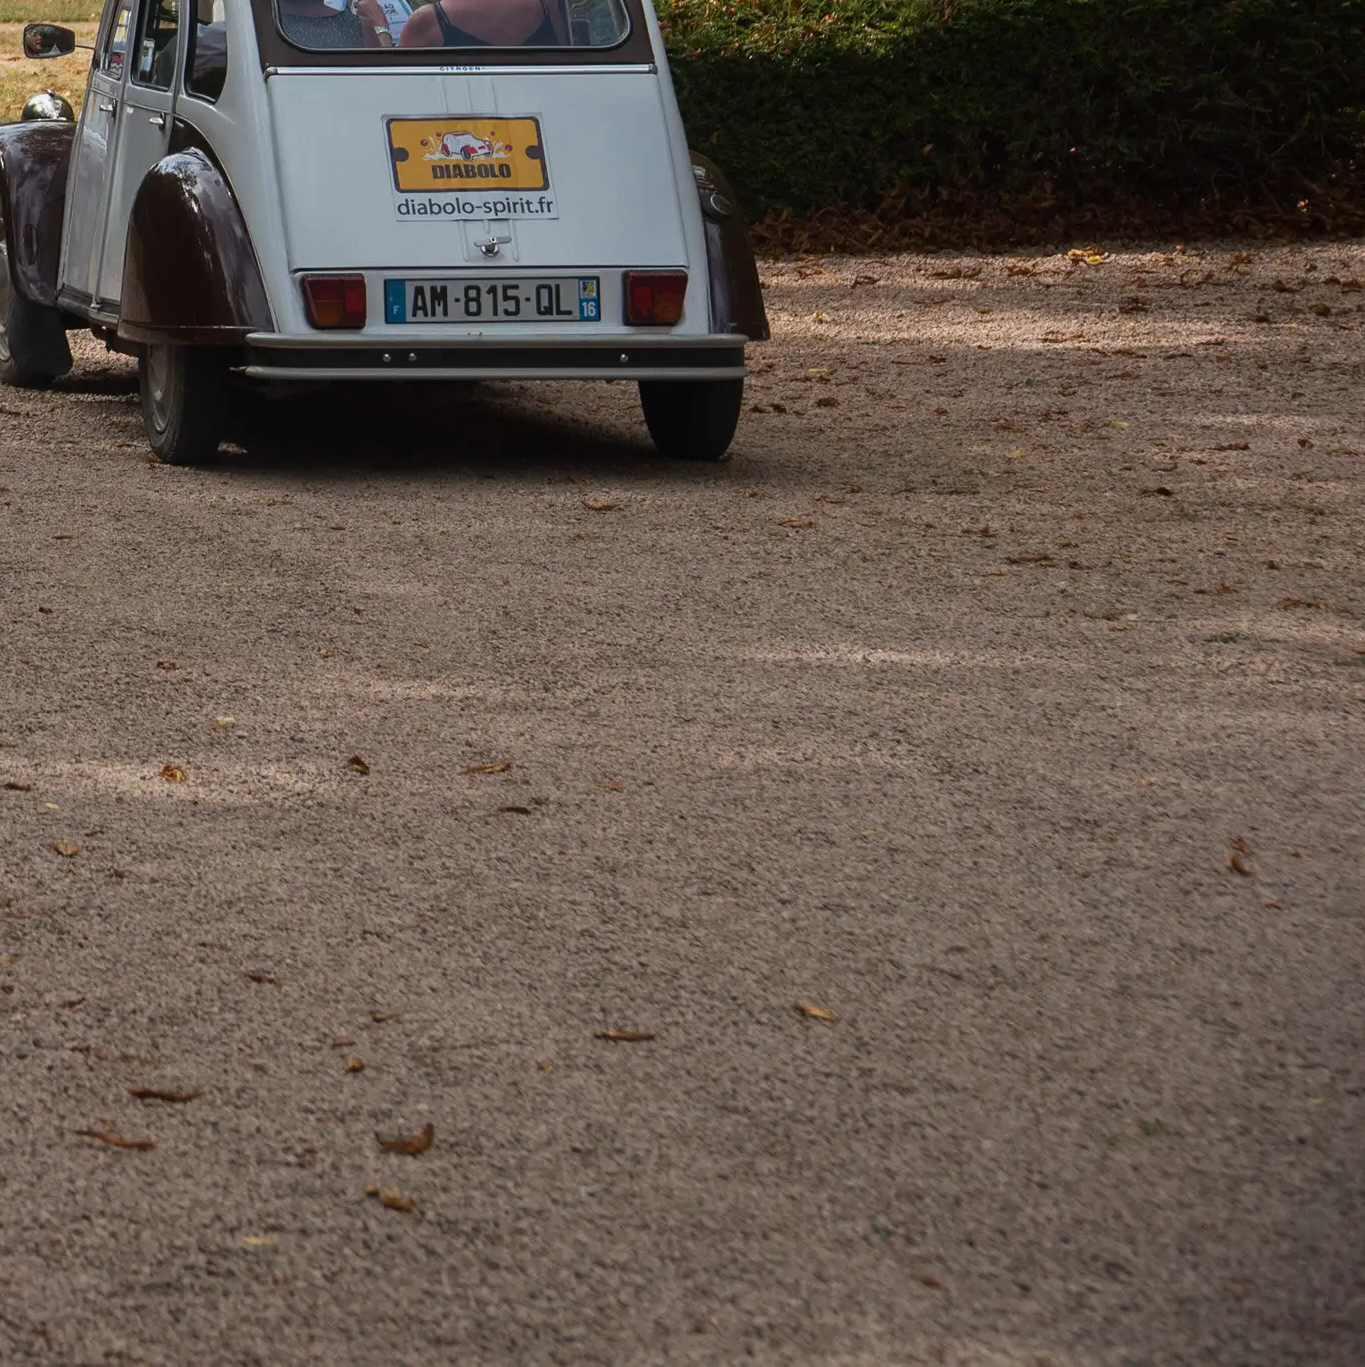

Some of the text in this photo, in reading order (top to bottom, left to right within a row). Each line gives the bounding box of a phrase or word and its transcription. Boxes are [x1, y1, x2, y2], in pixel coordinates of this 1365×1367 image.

[431, 163, 512, 179] DIABOLO
[397, 196, 554, 217] diabolo-spirit.fr
[393, 283, 597, 318] F AM-815-QL 16
